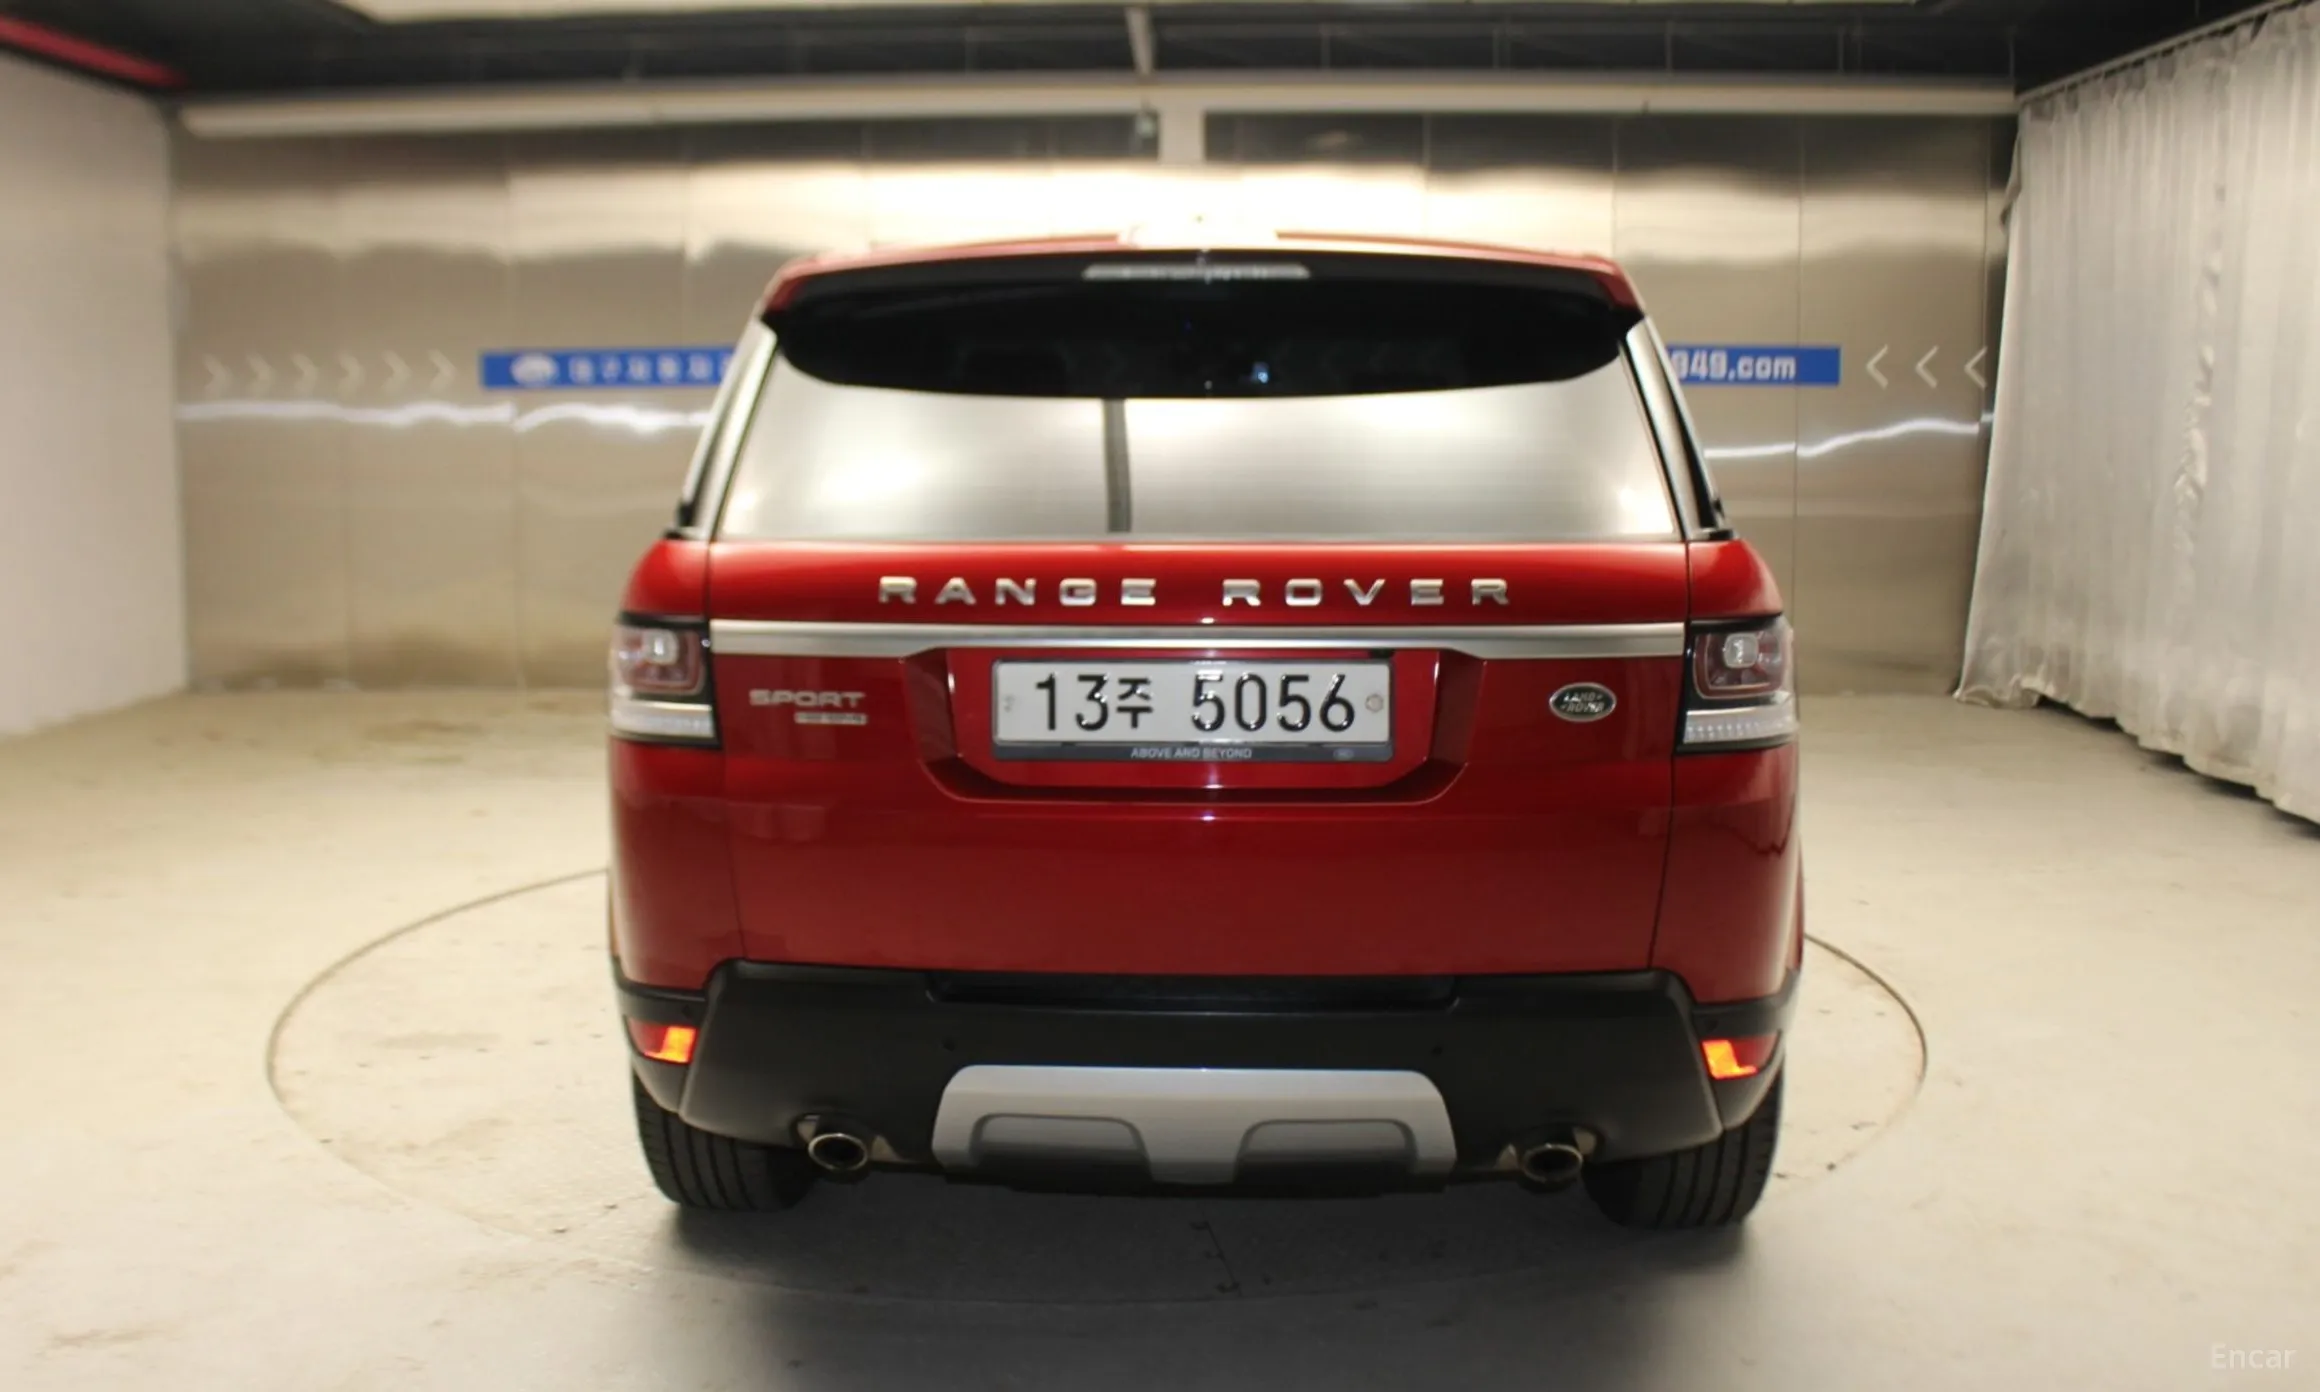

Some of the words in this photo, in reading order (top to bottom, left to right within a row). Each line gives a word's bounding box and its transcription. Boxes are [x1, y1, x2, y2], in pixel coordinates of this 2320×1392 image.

[879, 577, 1156, 606] RANGE
[1222, 578, 1510, 605] ROVER
[749, 690, 866, 707] SPORT
[1036, 673, 1153, 731] 13주
[1191, 673, 1355, 731] 5056
[1131, 748, 1171, 759] ABOVE
[1174, 748, 1199, 759] AND
[1203, 748, 1252, 759] BEYOND
